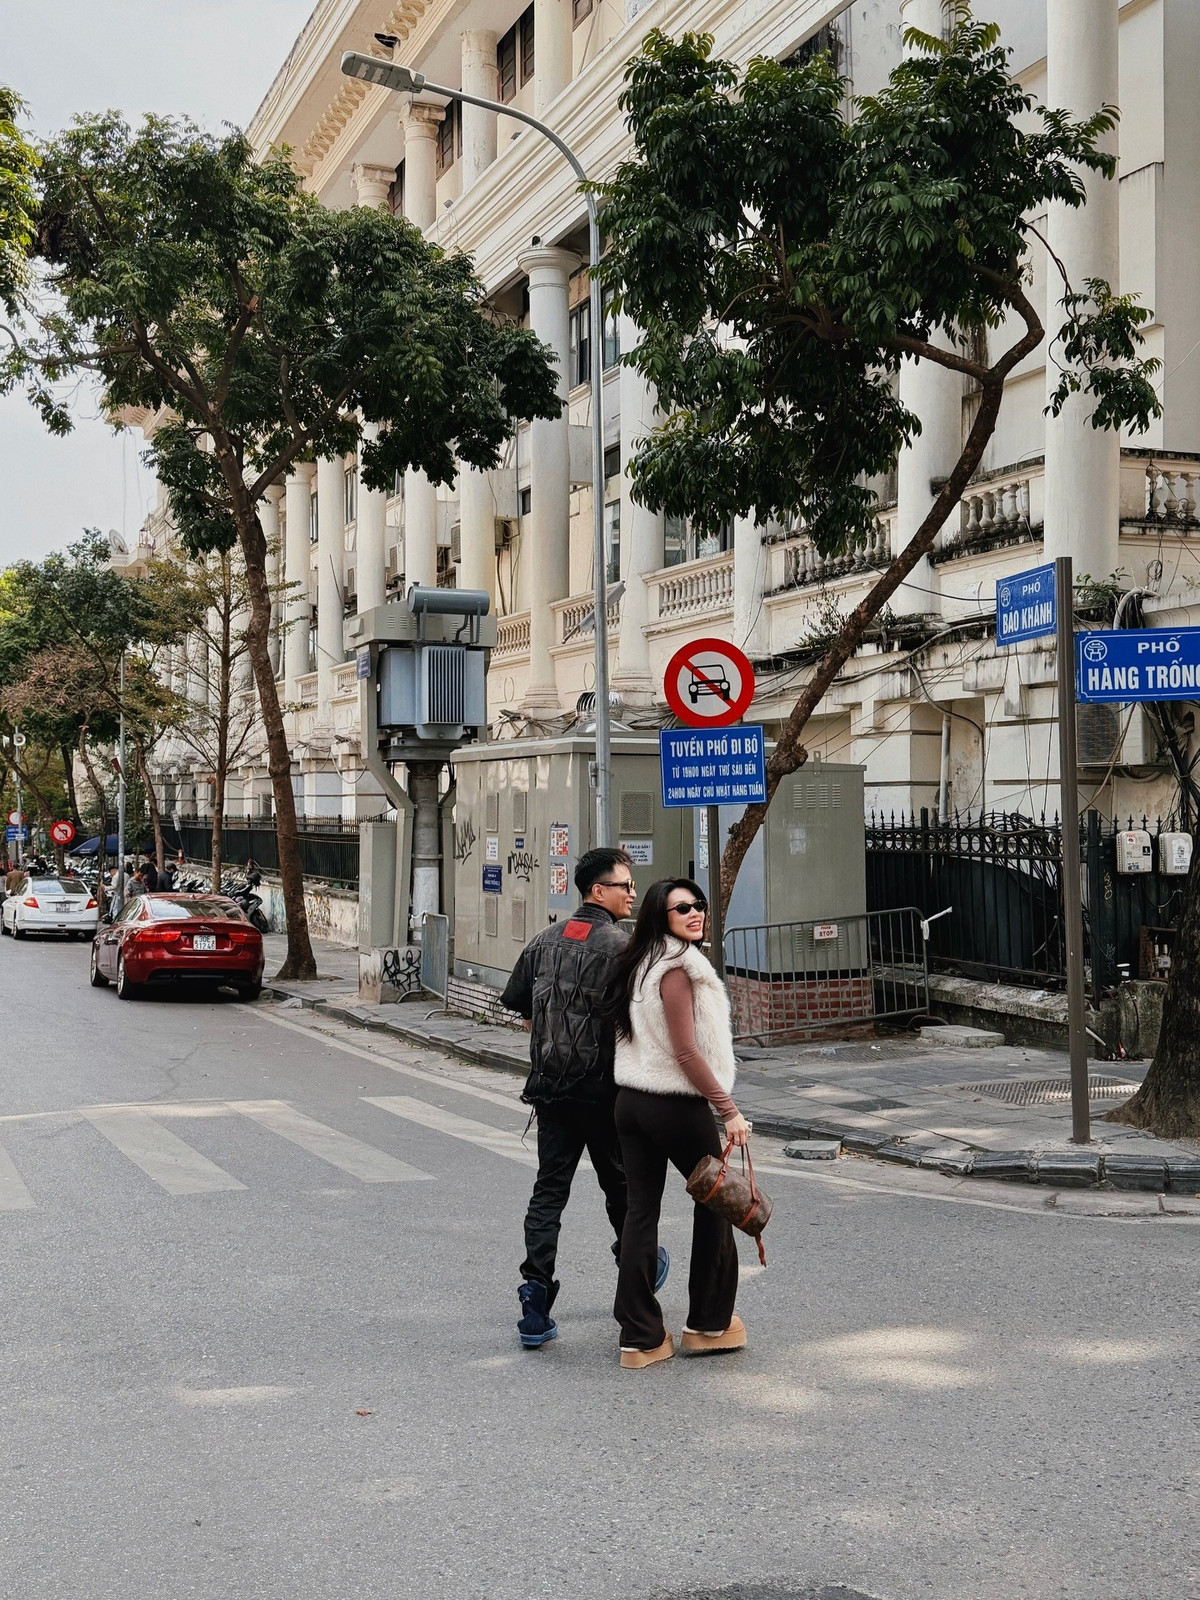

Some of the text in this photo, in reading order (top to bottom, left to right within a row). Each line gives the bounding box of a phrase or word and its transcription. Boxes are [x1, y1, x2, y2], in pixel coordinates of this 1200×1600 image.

[1022, 576, 1041, 596] PHỐ
[1021, 600, 1053, 630] KHÁNH
[1137, 635, 1181, 654] PHỐ
[1087, 662, 1139, 691] HÀNG
[670, 734, 758, 758] TUYẾN PHỐ ĐI BỘ
[701, 763, 716, 777] NGÀY
[731, 761, 743, 776] SÁU
[744, 760, 756, 775] ĐẾN
[687, 783, 701, 799] NGÀY
[716, 782, 731, 799] NHẬT
[732, 782, 748, 797] HÀNG
